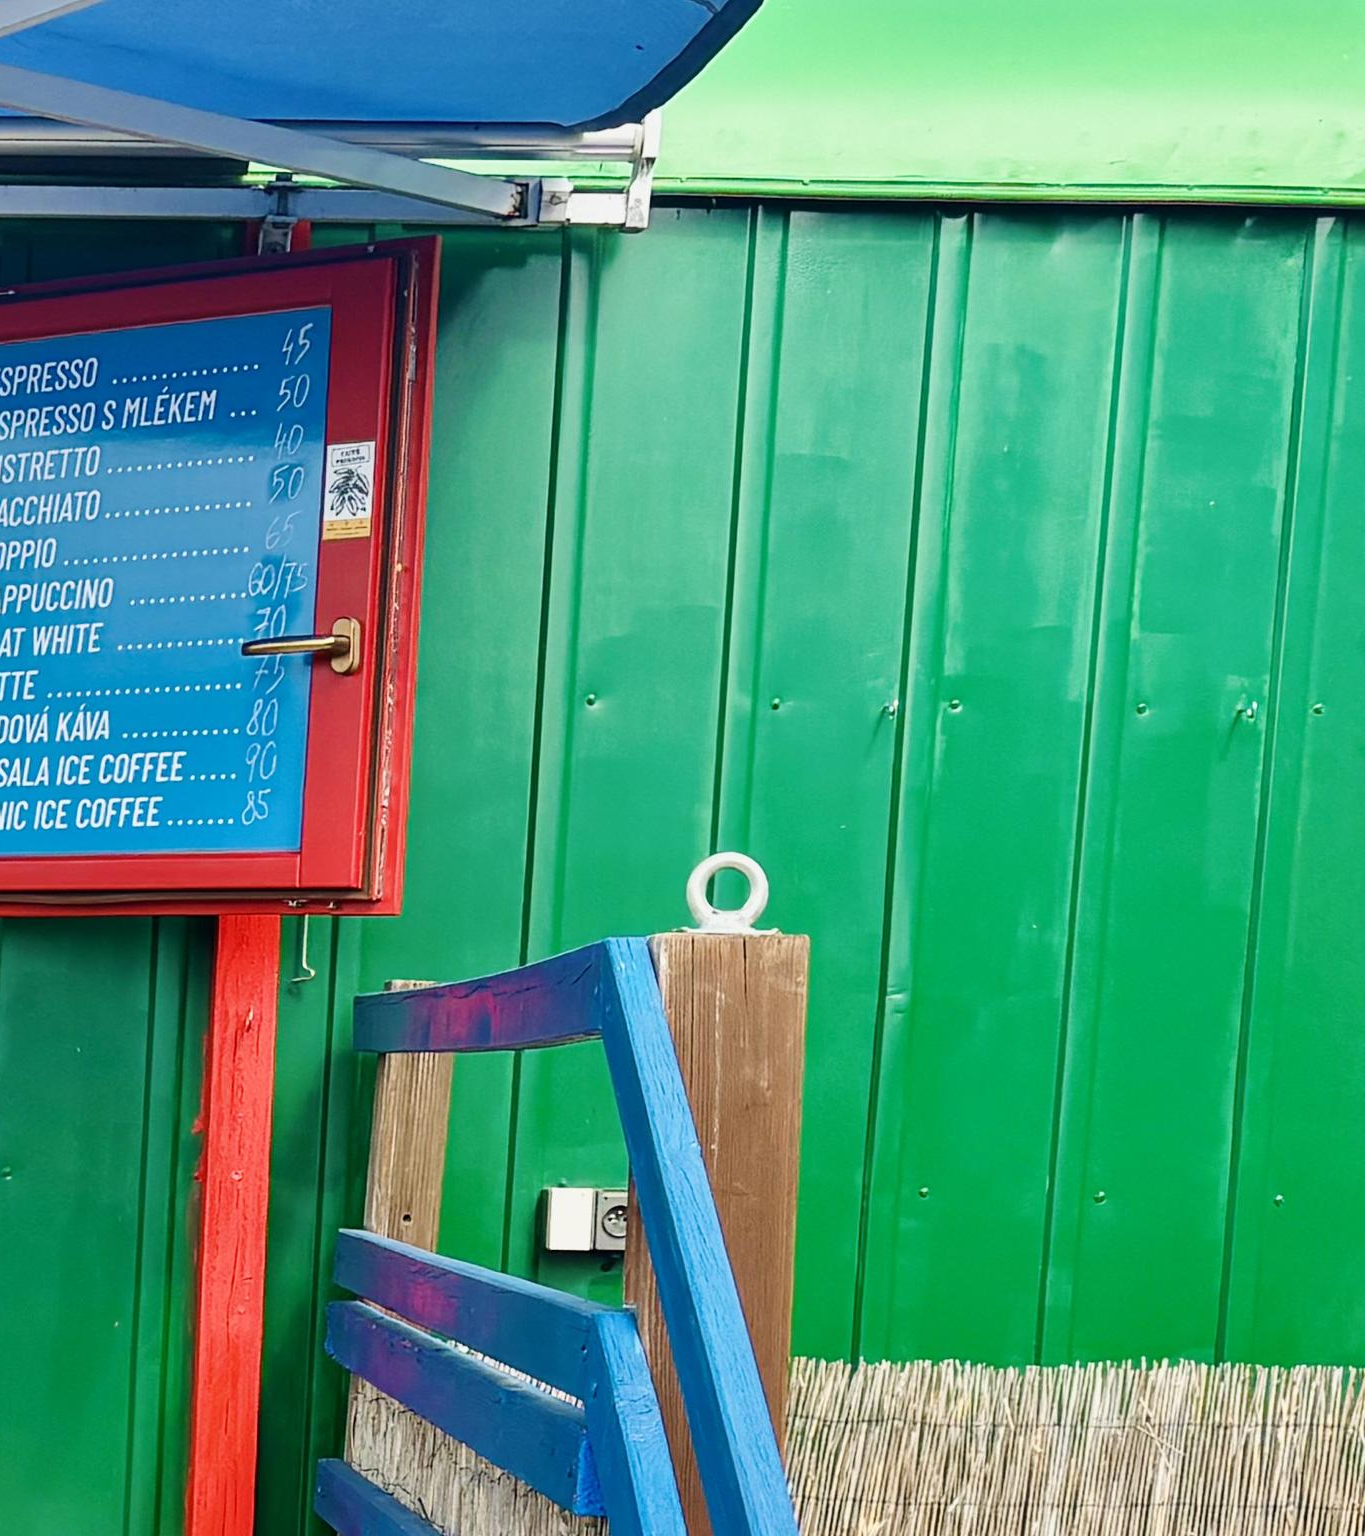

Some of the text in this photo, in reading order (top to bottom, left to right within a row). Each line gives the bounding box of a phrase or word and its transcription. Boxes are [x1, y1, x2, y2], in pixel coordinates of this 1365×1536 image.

[281, 322, 315, 366] 45
[101, 400, 115, 431] S
[122, 386, 218, 429] MLÉKEM
[276, 373, 310, 413] 50
[274, 423, 304, 460] 40
[268, 465, 306, 504] 50
[31, 622, 105, 657] WHITE
[54, 702, 111, 742] KÁVA
[245, 698, 278, 737] 80
[56, 754, 94, 787] ICE
[98, 750, 187, 785] COFFEE
[245, 741, 277, 784] 90
[33, 799, 71, 830] ICE
[74, 796, 164, 829] COFFEE
[241, 789, 272, 826] 85
